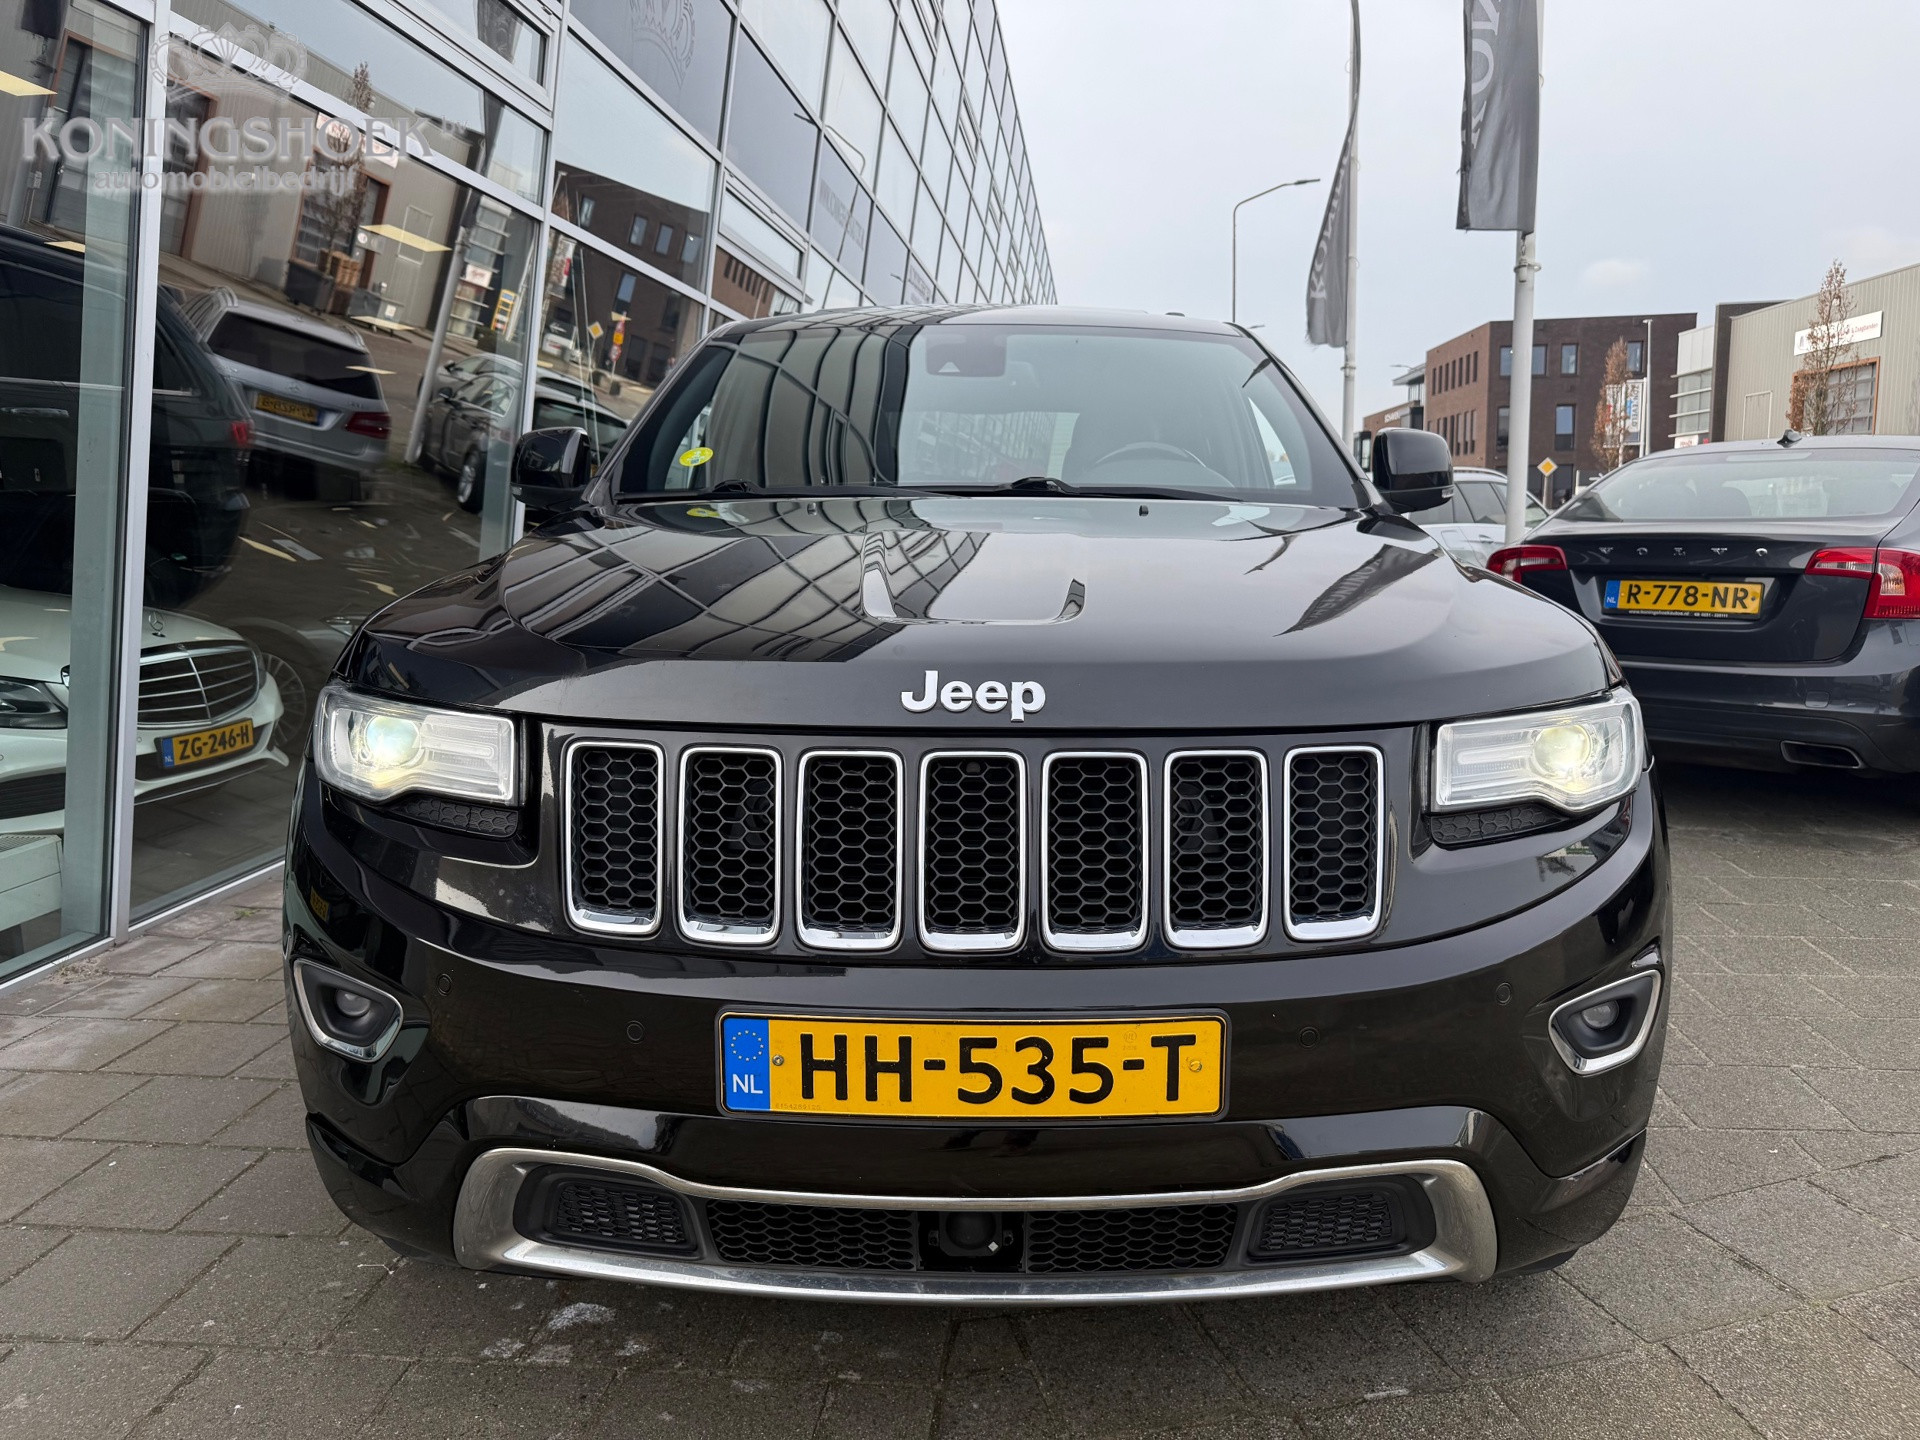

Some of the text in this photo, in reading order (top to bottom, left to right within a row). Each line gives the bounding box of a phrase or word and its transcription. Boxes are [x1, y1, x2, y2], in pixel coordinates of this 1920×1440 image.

[1626, 583, 1749, 609] R-778-NR
[901, 670, 1047, 723] Jeep
[178, 725, 250, 760] ZG-246-H
[732, 1074, 764, 1094] NL
[800, 1033, 1197, 1105] HH-535-T
